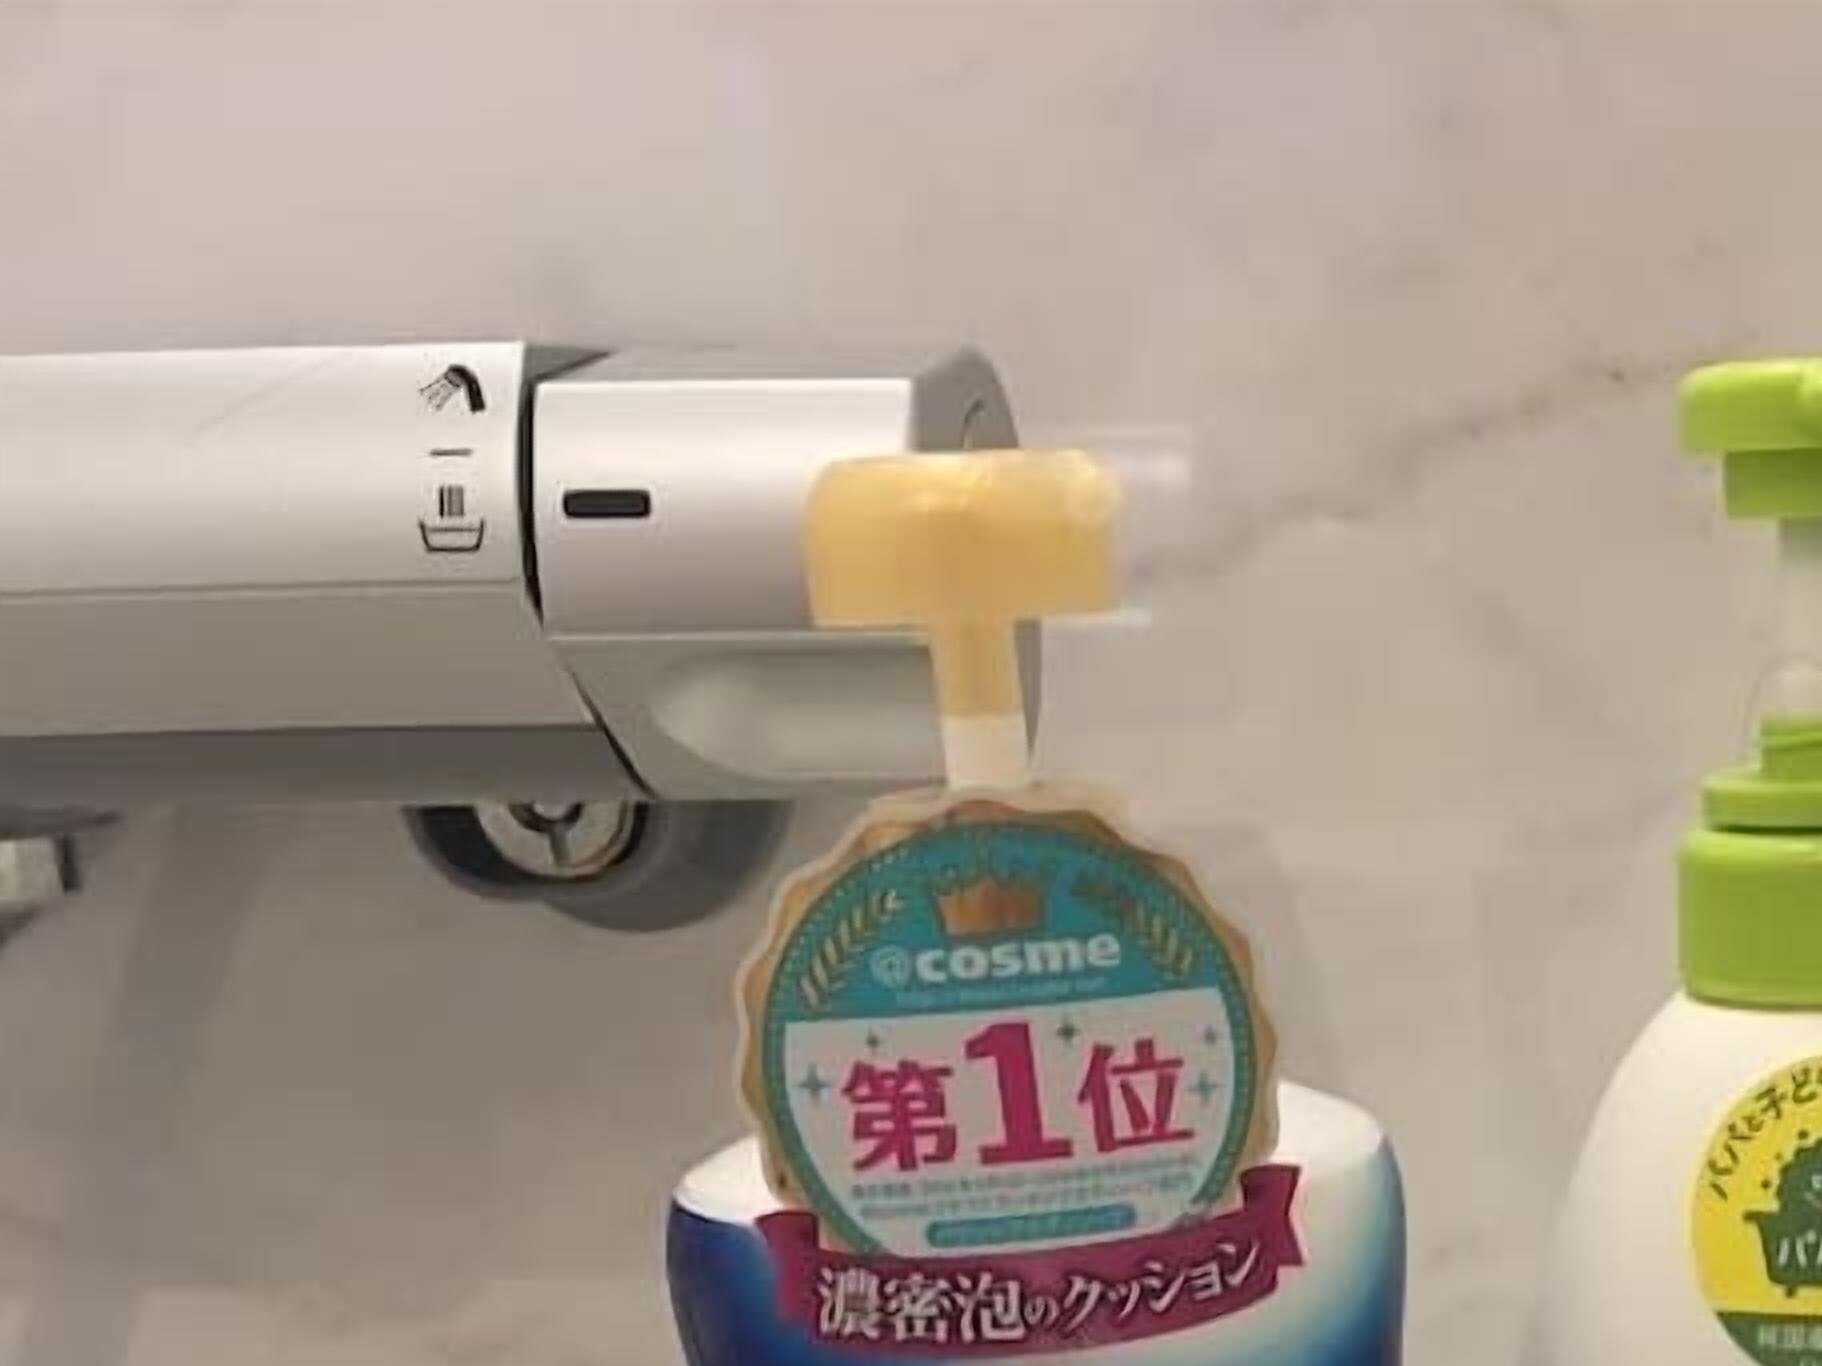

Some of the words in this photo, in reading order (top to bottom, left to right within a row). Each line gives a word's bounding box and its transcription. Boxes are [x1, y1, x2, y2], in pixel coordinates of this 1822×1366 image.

[869, 933, 1121, 989] @cosme
[840, 1022, 1196, 1171] 第1位
[816, 1240, 1261, 1342] 濃密泡のクッション
